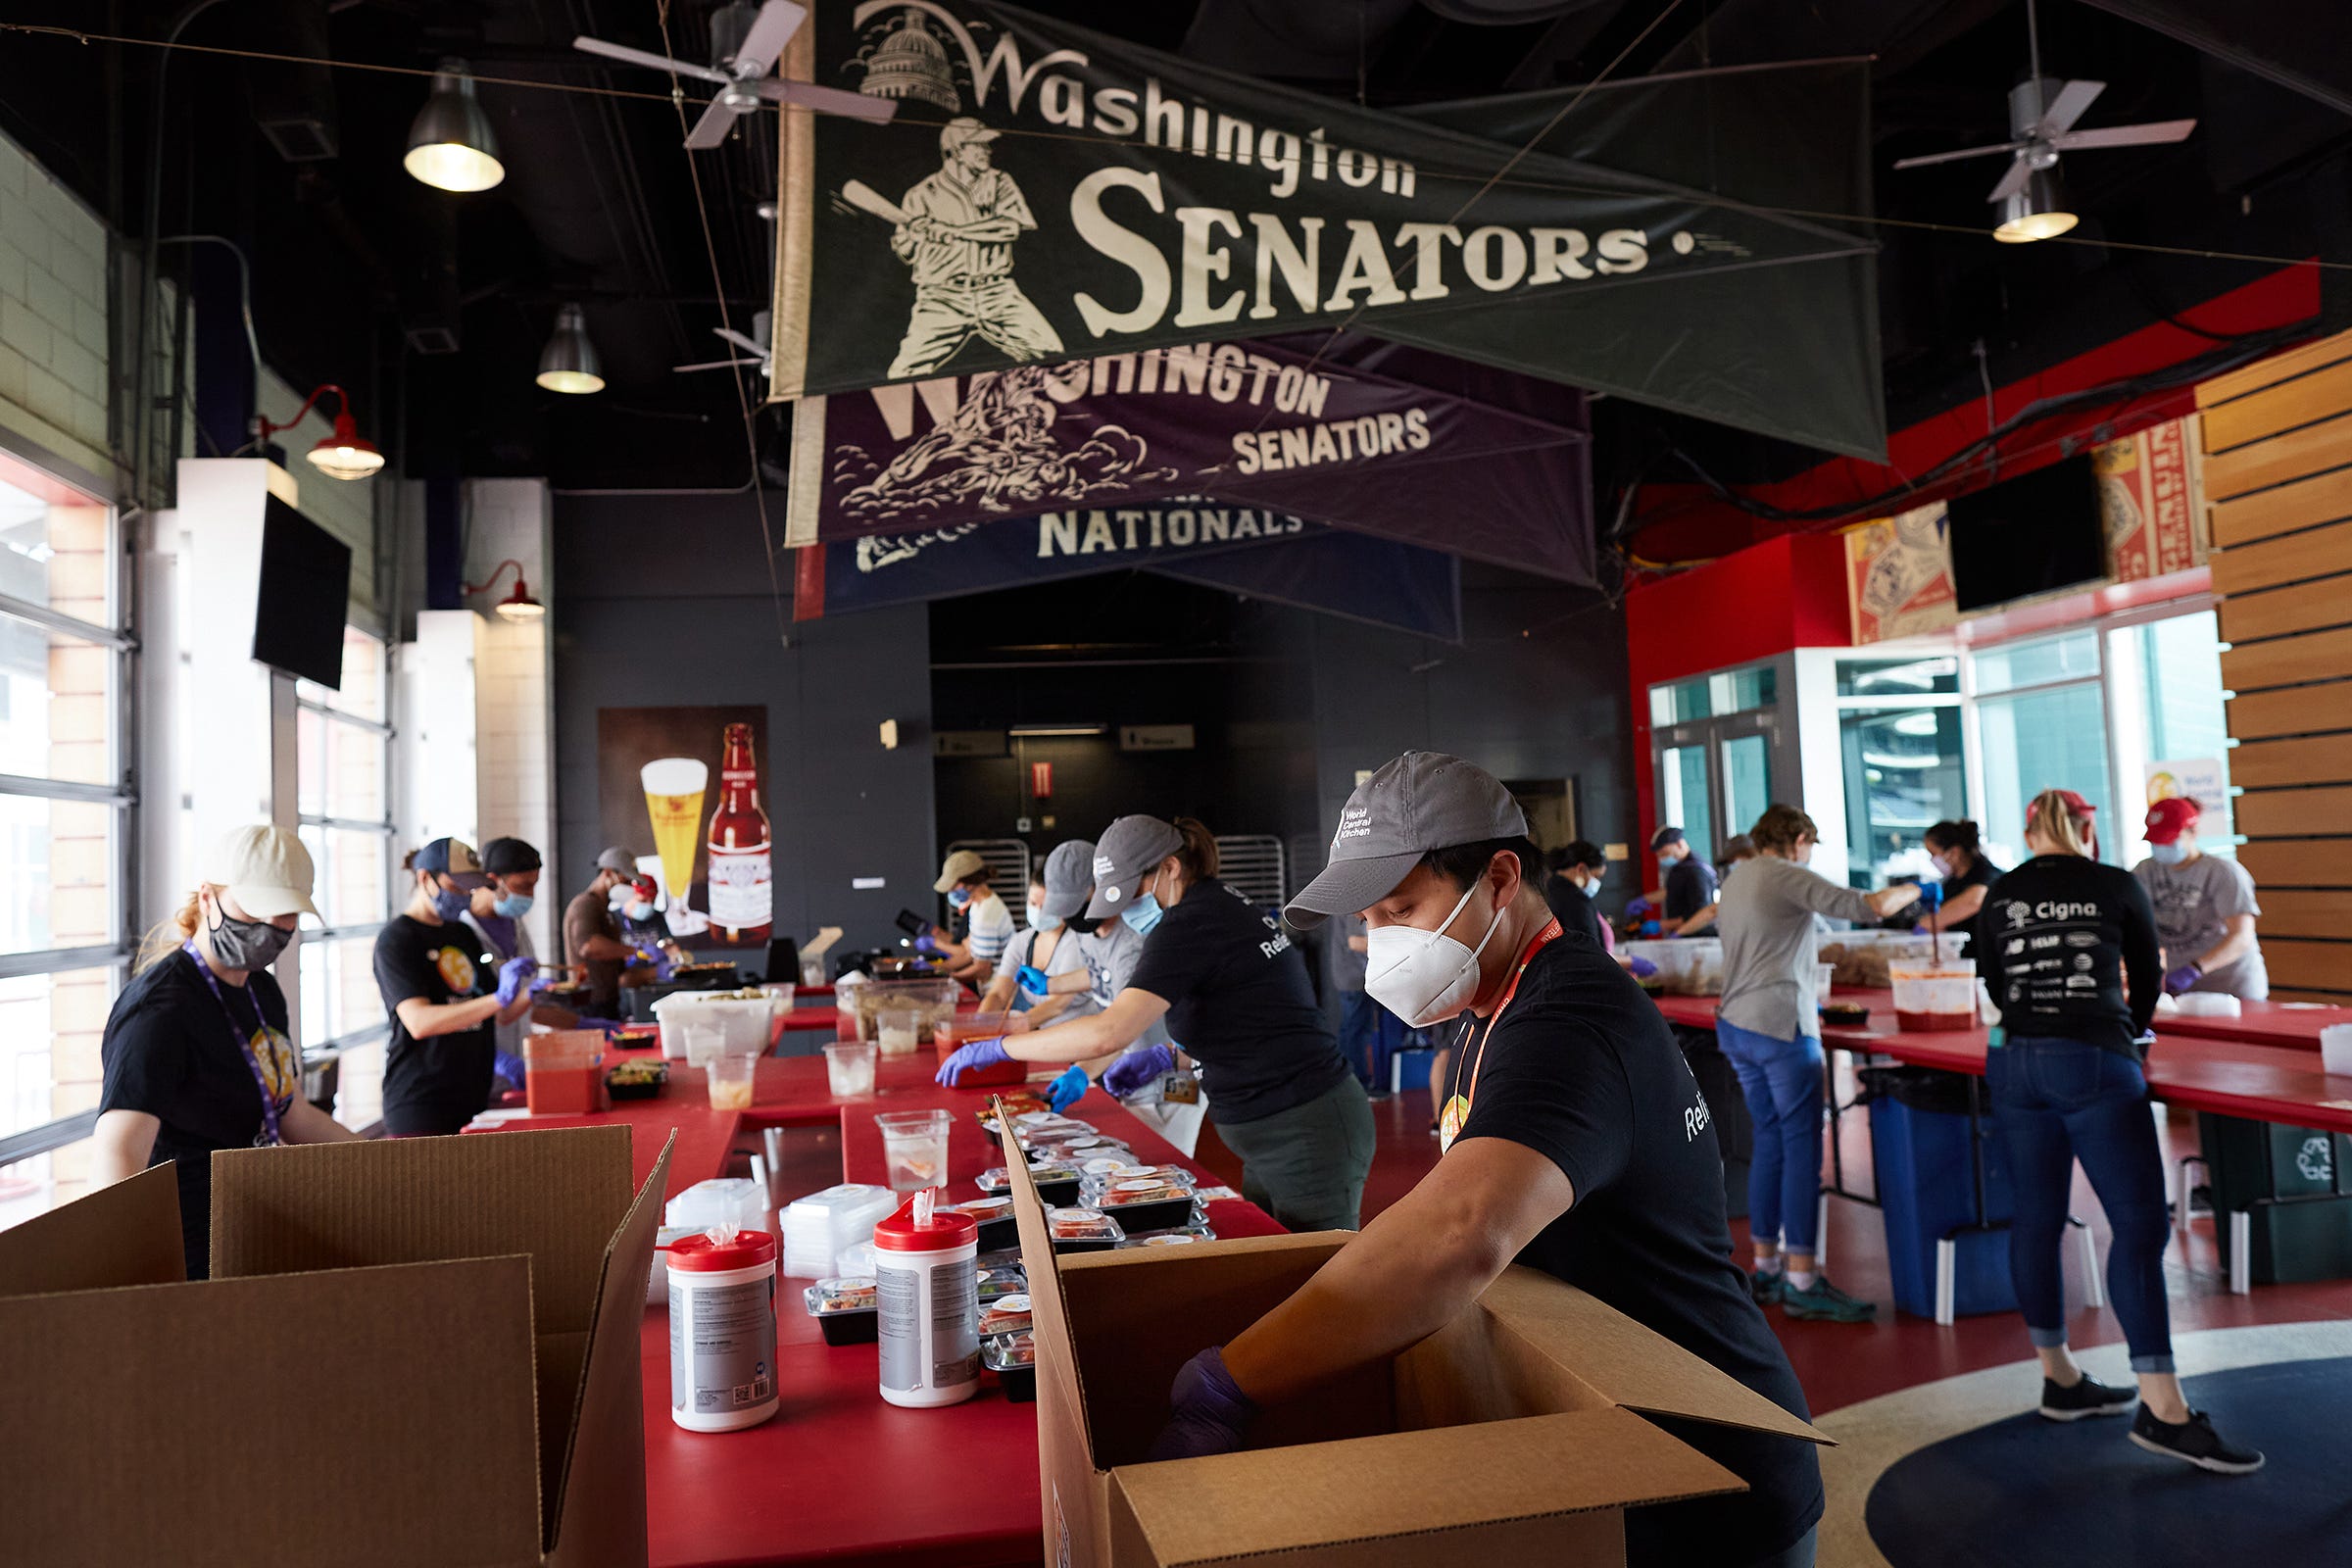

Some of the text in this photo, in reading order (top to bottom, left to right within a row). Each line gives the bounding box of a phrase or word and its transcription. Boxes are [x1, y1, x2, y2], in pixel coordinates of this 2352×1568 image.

[854, 0, 1416, 198] Washington
[1070, 166, 1649, 338] SENATORS
[1232, 408, 1431, 475] SENATORS
[1036, 509, 1303, 559] NATIONALS
[1343, 816, 1372, 830] Central
[1346, 808, 1367, 820] World
[1340, 828, 1370, 840] Kitchen
[2035, 901, 2097, 920] Cigna
